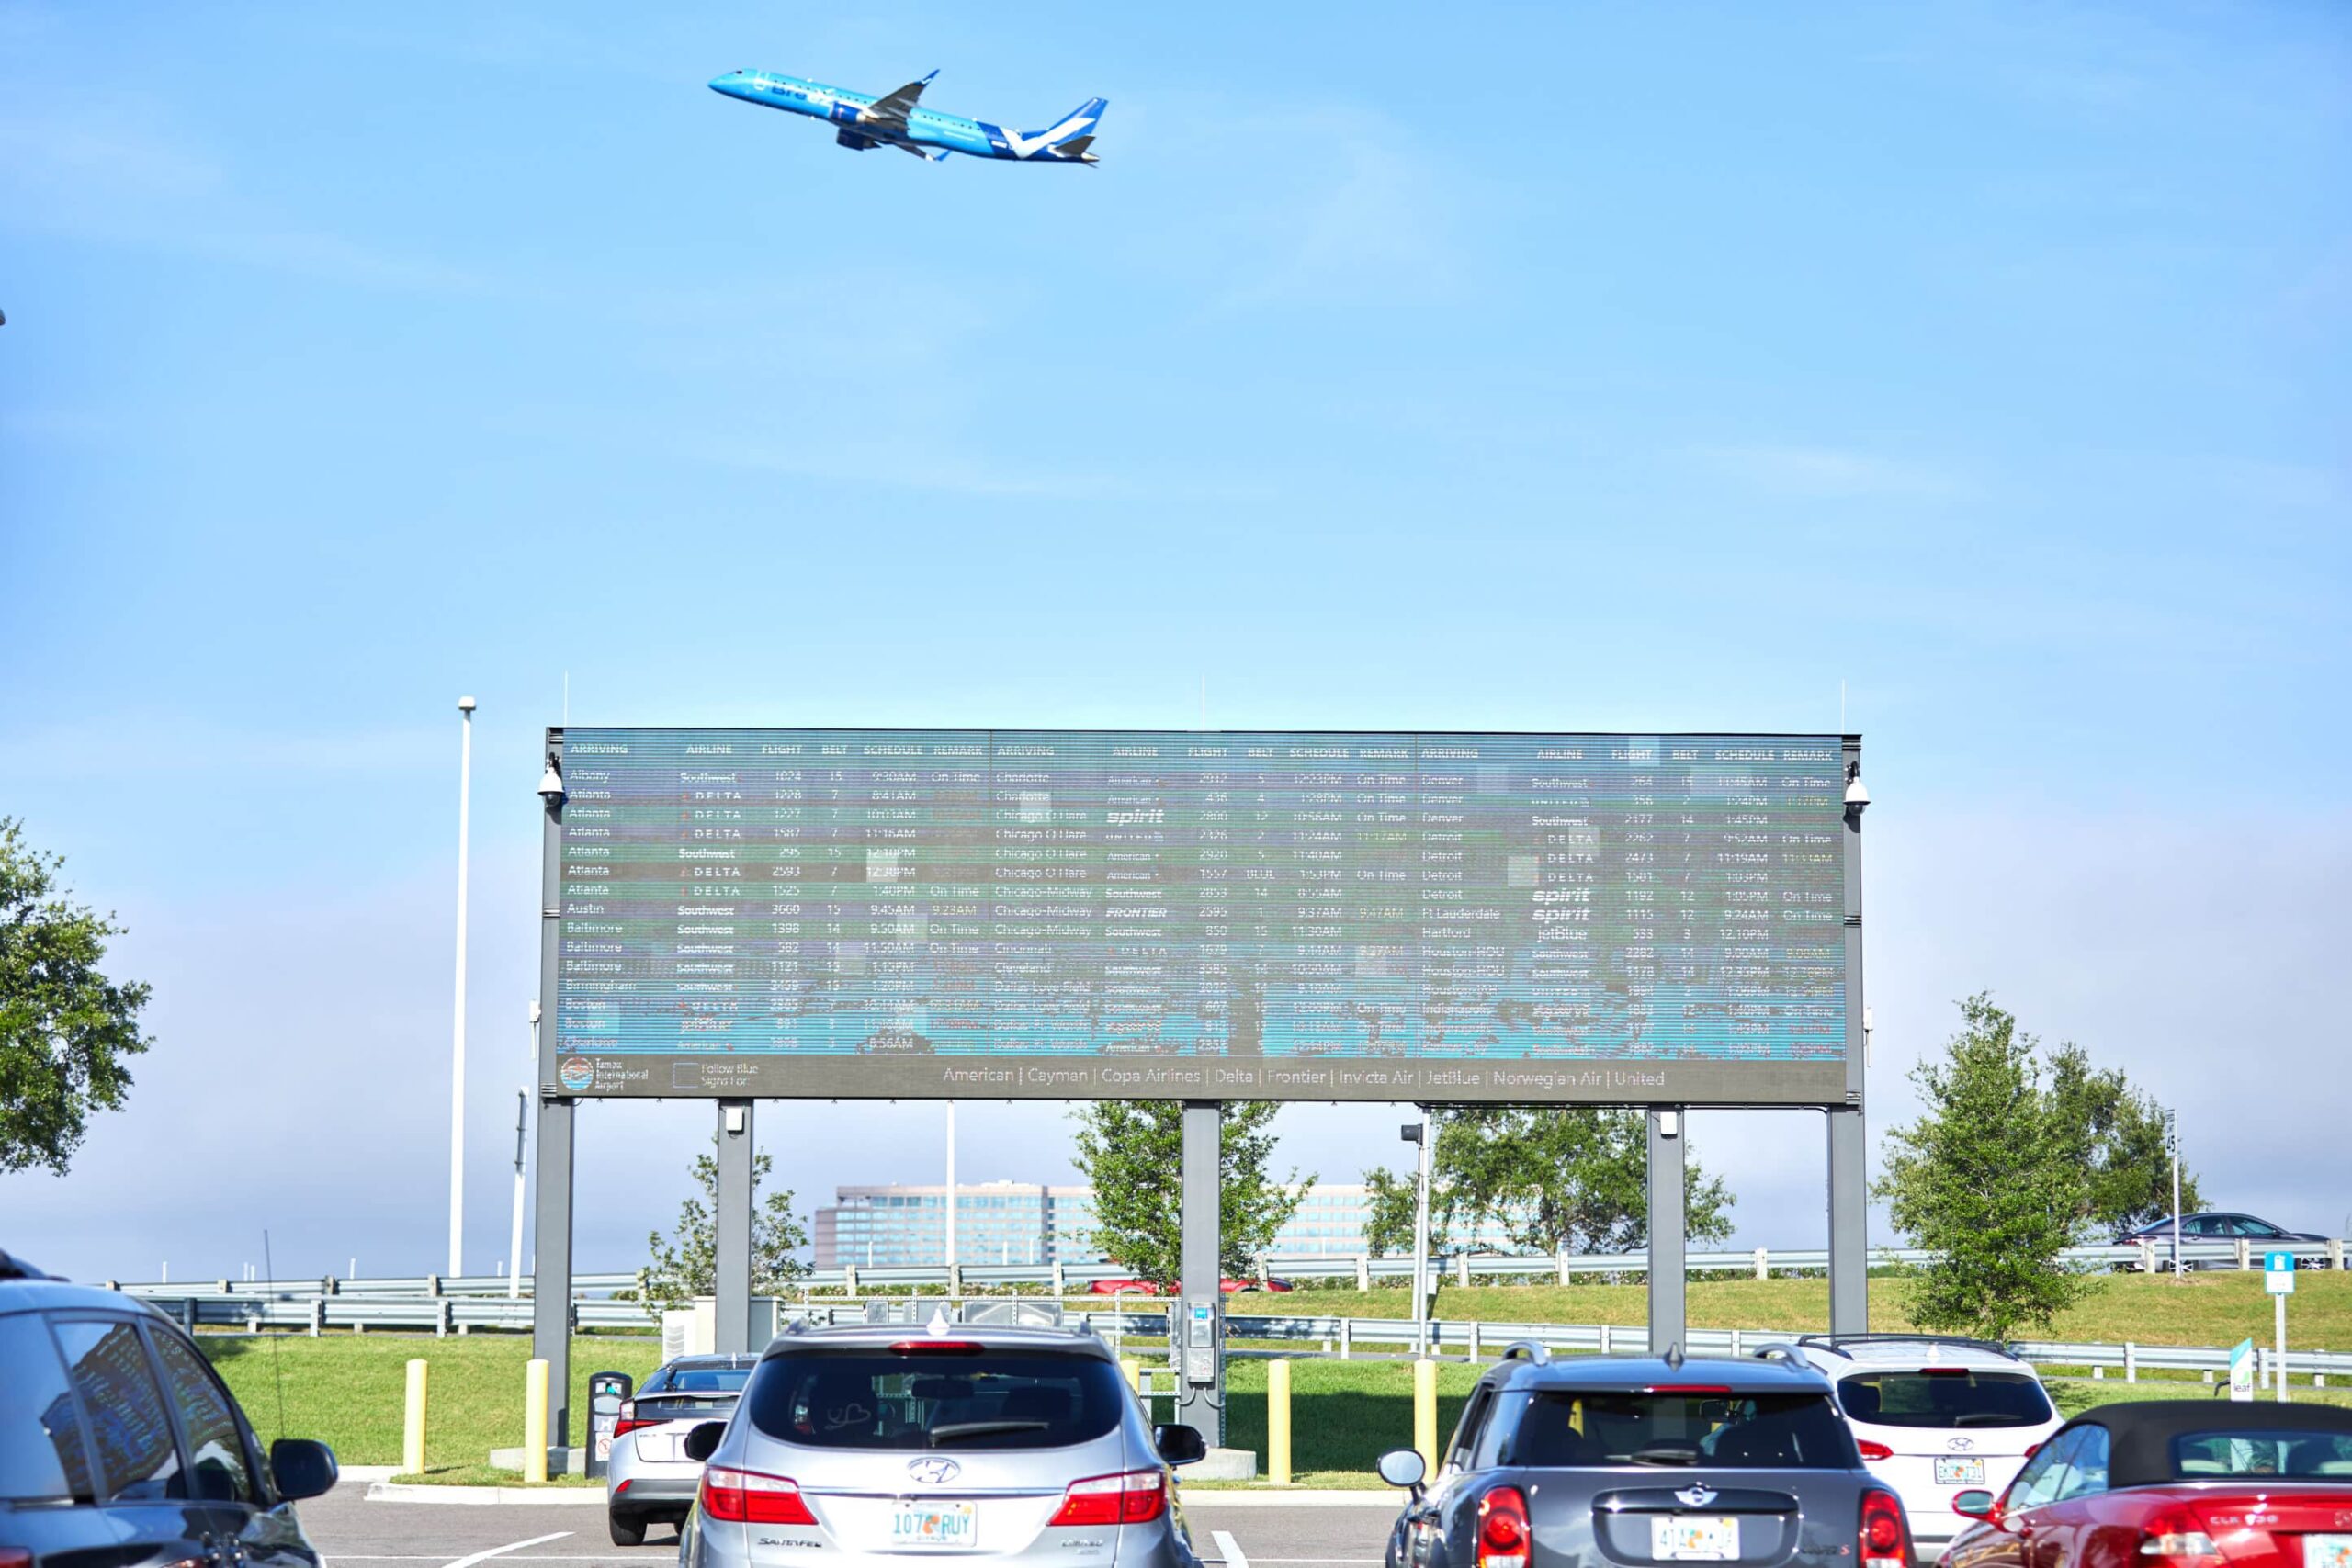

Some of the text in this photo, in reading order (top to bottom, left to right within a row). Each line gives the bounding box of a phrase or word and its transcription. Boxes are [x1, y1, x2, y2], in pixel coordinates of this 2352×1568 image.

[571, 744, 983, 755] ARRIVING AIRLINE FLIGHT BELT SCHEDULE REMARK
[998, 746, 1408, 758] ARRIVING AIRLINE FLIGHT BELT SCHEDULE REMARK
[1421, 749, 1833, 761] ARRIVING AIRLINE FLIGHT BELT SCHEDULE REMARK
[569, 770, 610, 783] Albany
[680, 773, 736, 783] Southwest
[932, 773, 948, 781] On
[952, 773, 980, 782] Time
[997, 773, 1049, 783] Charlotte
[1357, 774, 1374, 784] On
[1378, 774, 1406, 784] Time
[1422, 775, 1830, 788] Denver Southwest On Time
[570, 789, 611, 799] Atlanta
[696, 792, 741, 800] DELTA
[996, 792, 1406, 804] Charlotte On Time
[1422, 795, 1463, 804] Denver
[569, 809, 610, 818] Atlanta
[1106, 809, 1164, 826] spirit
[1357, 813, 1374, 822] On
[1378, 814, 1406, 822] Time
[1422, 814, 1464, 822] Denver
[1532, 816, 1588, 826] Southwest
[569, 828, 610, 837] Atlanta
[695, 830, 741, 839] DELTA
[1422, 833, 1831, 844] Detroit DELTA On Time
[568, 847, 735, 858] Atlanta Southwest
[996, 849, 1042, 861] Chicago
[1107, 852, 1150, 861] American
[1422, 852, 1463, 861] Detroit
[1548, 854, 1593, 863] DELTA
[568, 865, 740, 876] Atlanta DELTA
[995, 868, 1406, 880] Chicago American On Time
[1422, 871, 1593, 882] Detroit DELTA
[568, 885, 609, 895] Atlanta
[694, 887, 740, 896] DELTA
[931, 886, 948, 896] On
[952, 886, 979, 897] Time
[995, 886, 1161, 898] Chicago-Midway Southwest
[1422, 889, 1463, 899] Detroit
[1532, 888, 1590, 905] spirit
[1680, 892, 1694, 901] 12
[1783, 892, 1801, 901] On
[1804, 892, 1832, 902] Time
[567, 905, 604, 914] Austin
[677, 906, 734, 915] Southwest
[995, 906, 1091, 918] Chicago-Midway
[1105, 908, 1167, 917] FRONTIER
[1437, 909, 1501, 919] Lauderdale
[1532, 907, 1591, 924] spirit
[1680, 911, 1694, 920] 12
[1783, 911, 1801, 921] On
[1804, 911, 1832, 921] Time
[567, 923, 622, 932] Baltimore
[677, 925, 734, 933] Southwest
[827, 924, 840, 933] 14
[930, 924, 947, 933] On
[951, 924, 979, 934] Time
[995, 925, 1161, 937] Chicago-Midway Southwest
[1422, 928, 1470, 938] Hartford
[1537, 926, 1587, 942] jetBlue
[567, 942, 622, 952] Baltimore
[677, 943, 734, 953] Southwest
[930, 943, 947, 953] On
[951, 943, 978, 953] Time
[1532, 949, 1588, 958] Southwest
[566, 961, 622, 971] Baltimore
[702, 1063, 759, 1074] Follow Blue
[595, 1069, 648, 1080] International
[943, 1067, 1665, 1089] American Cayman Copa Airlines Delta Frontier Invicta Air JetBlue Norwegian Air United
[595, 1081, 624, 1092] Airport
[702, 1077, 729, 1088] Signs
[2233, 1383, 2250, 1392] leaf
[894, 1514, 969, 1534] 107 RUY
